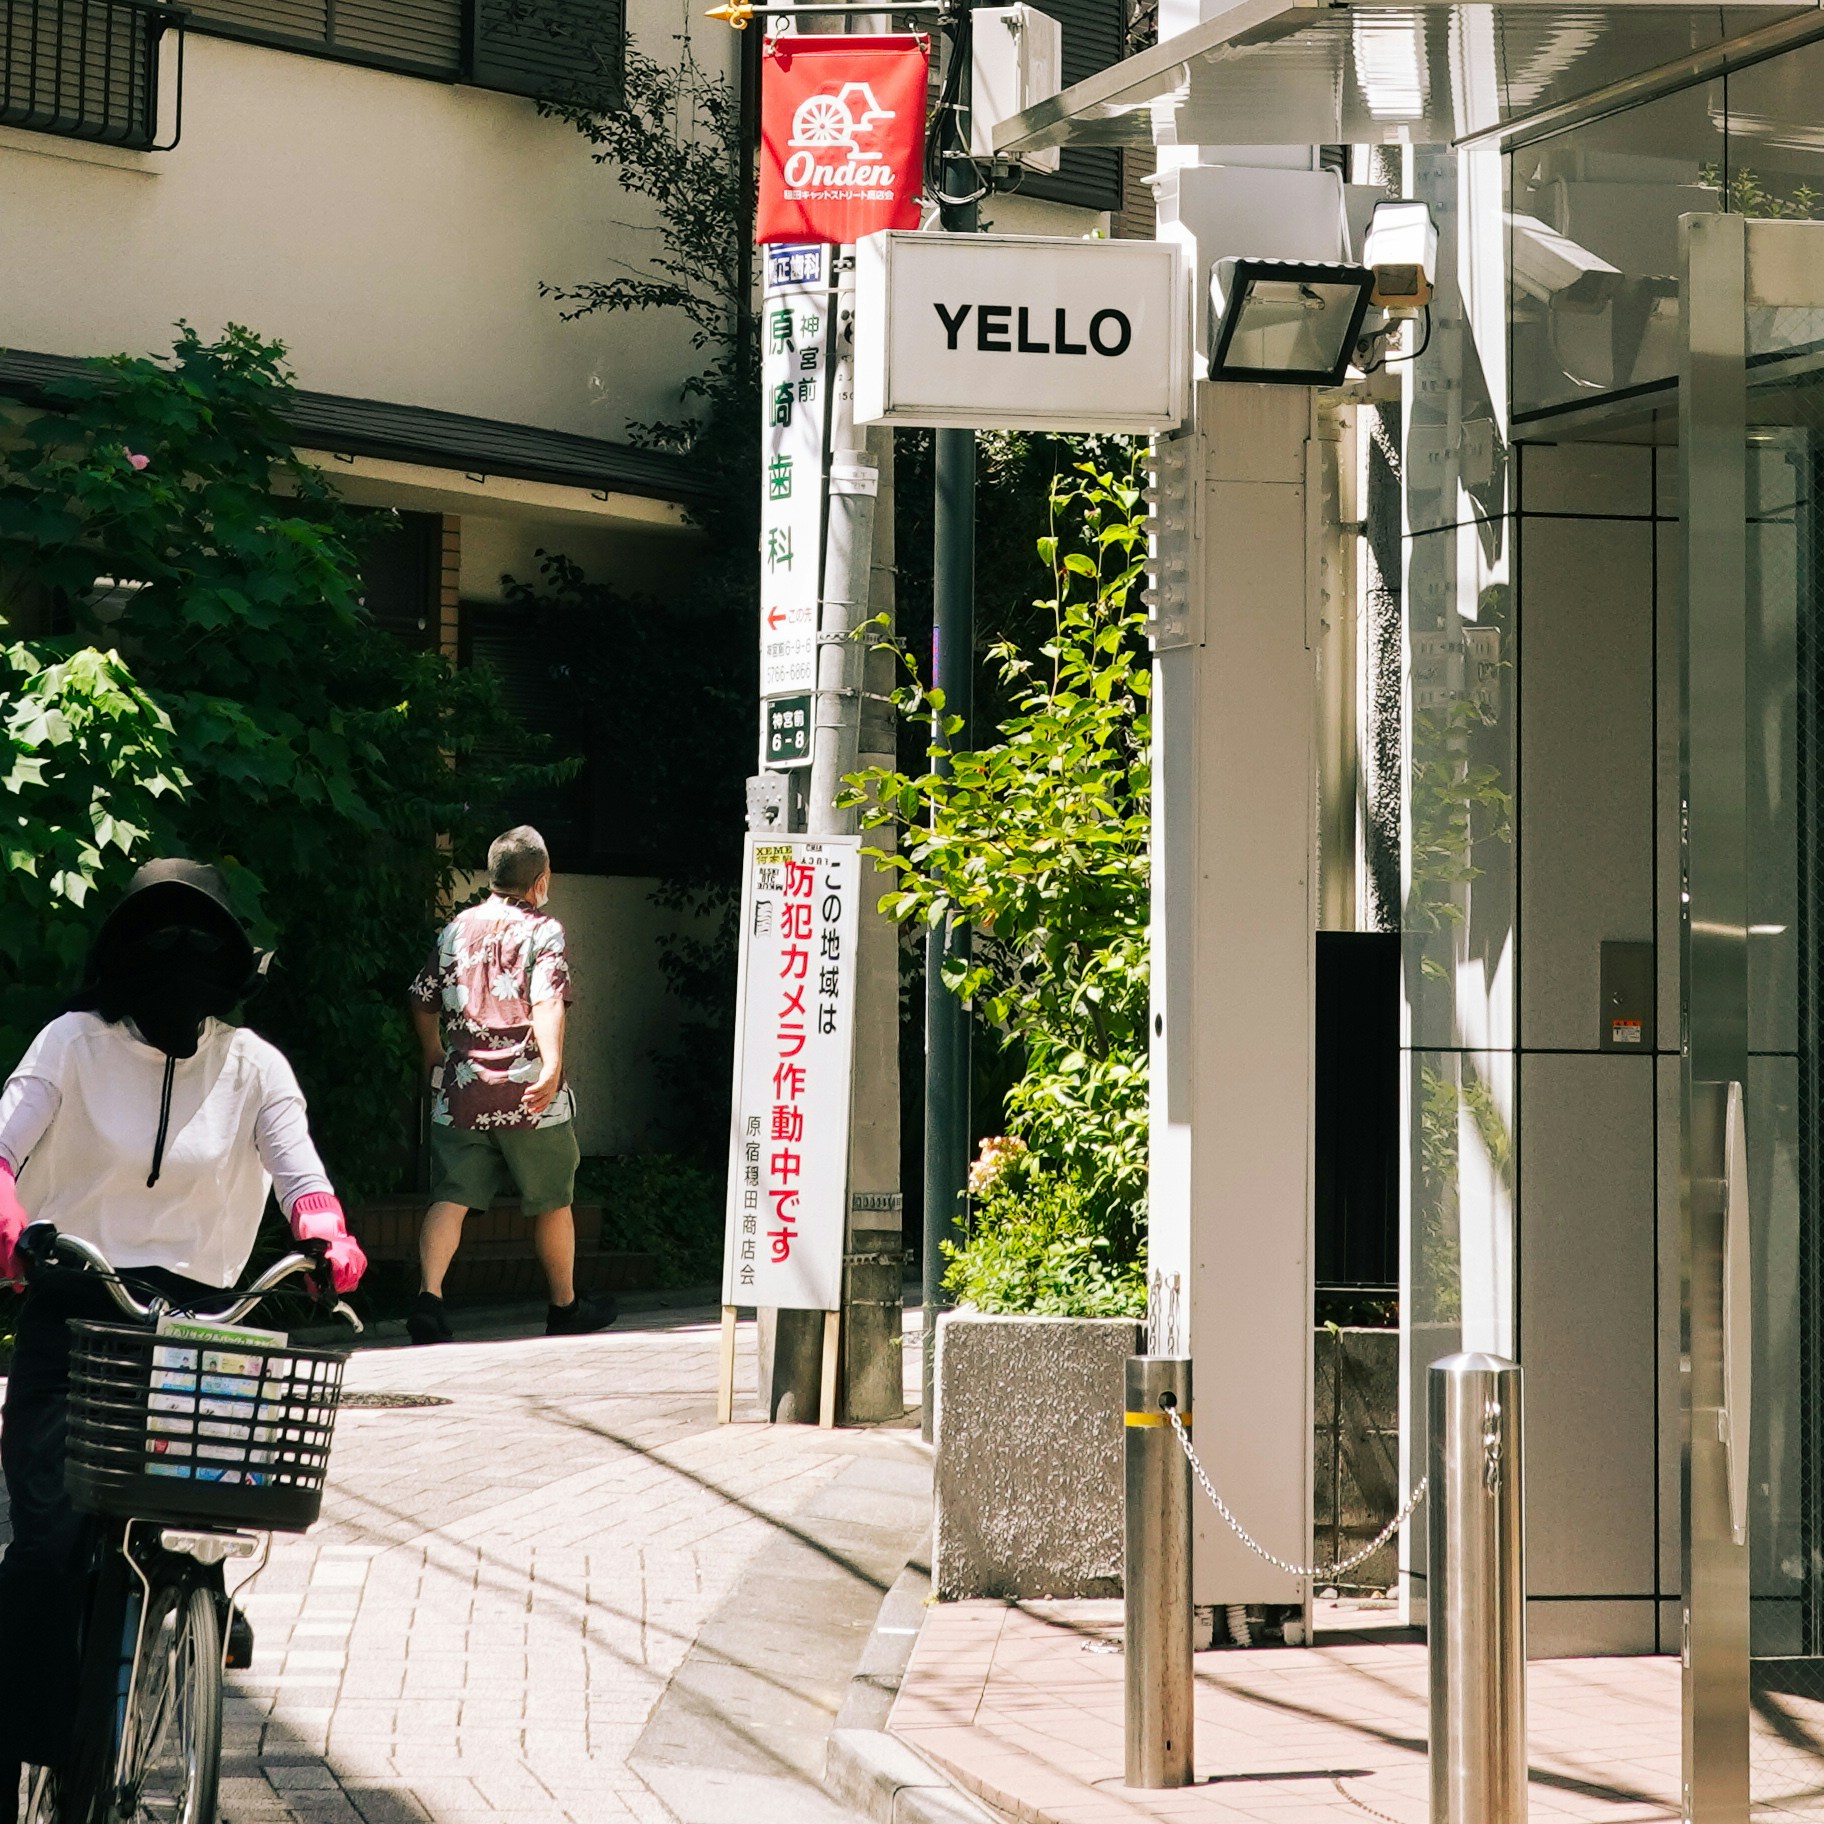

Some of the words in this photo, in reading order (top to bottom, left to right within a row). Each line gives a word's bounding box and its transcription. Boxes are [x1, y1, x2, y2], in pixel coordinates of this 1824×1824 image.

[783, 150, 896, 187] Onden
[798, 314, 820, 403] 神宮前
[933, 303, 1132, 357] YELLO
[772, 709, 805, 730] 神宮前
[772, 730, 805, 751] 6-8
[819, 862, 842, 1035] この地域は
[767, 861, 816, 1263] 防犯カメラ作動中です
[740, 1116, 761, 1286] 原宿穏田商店会
